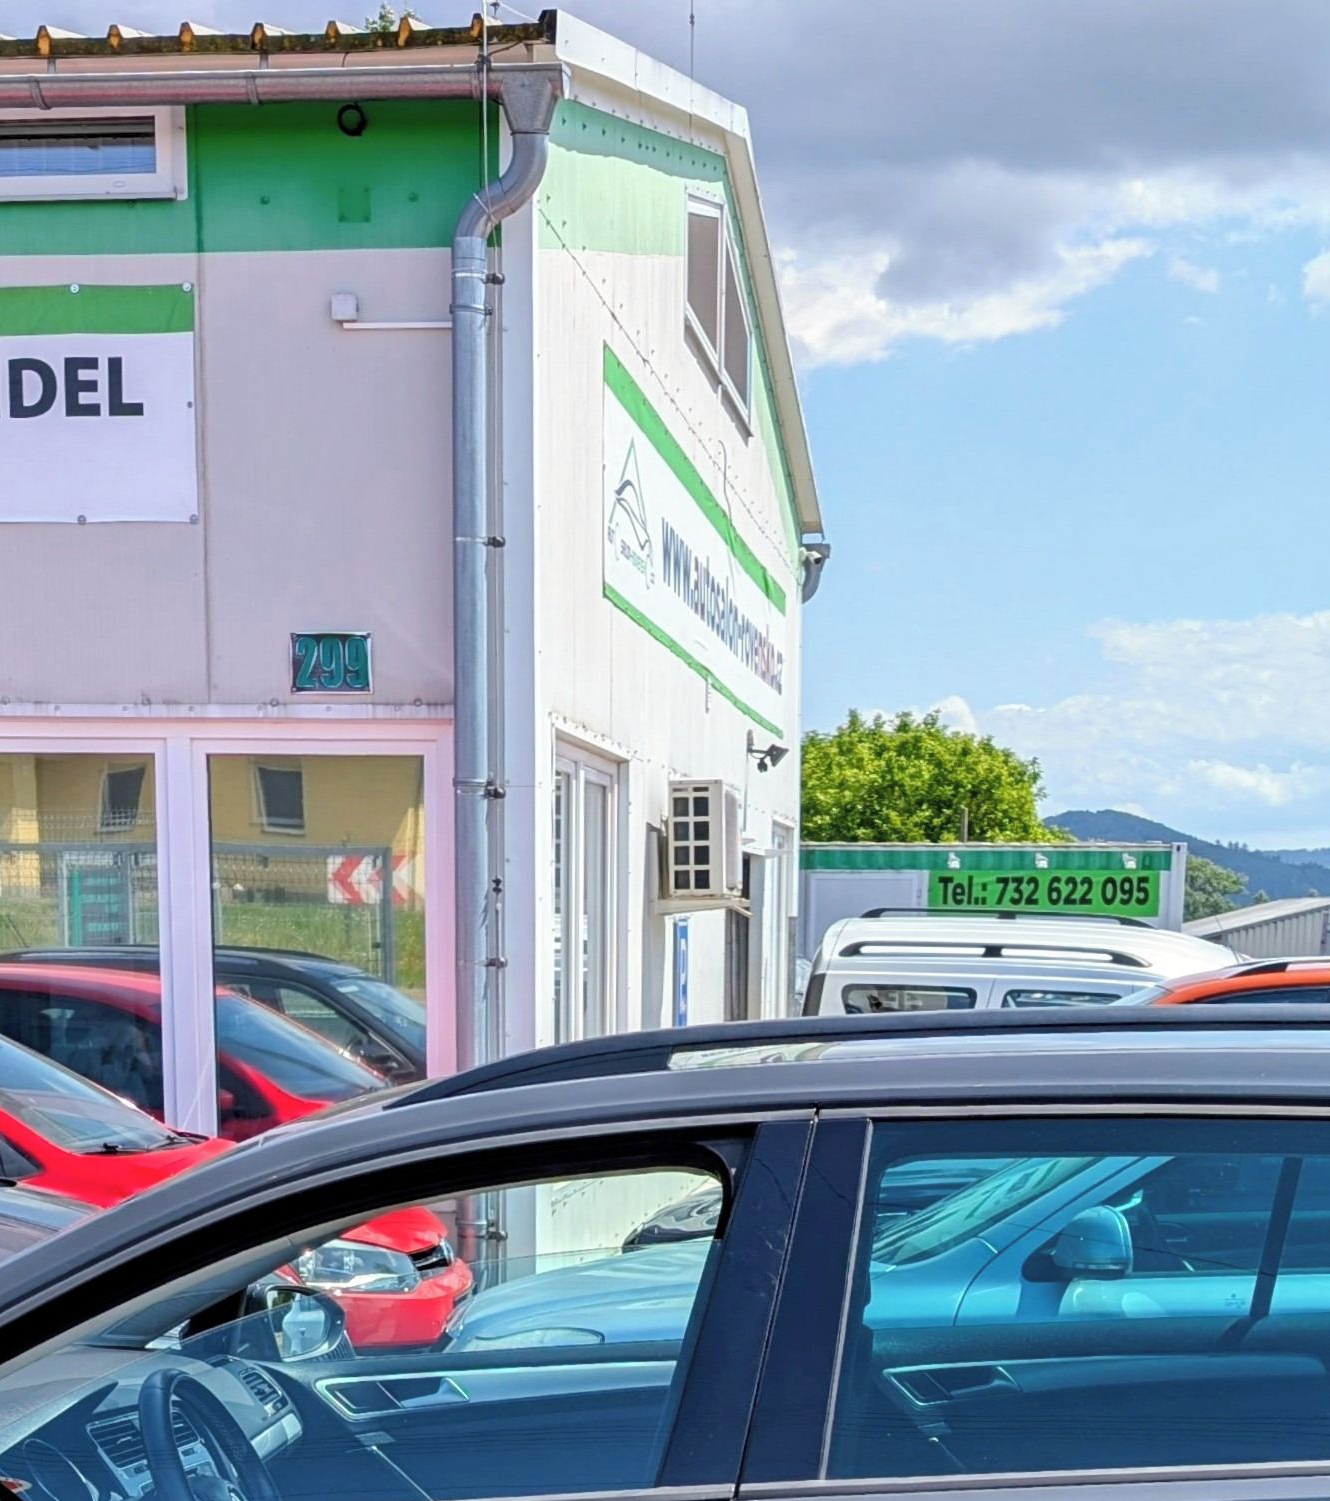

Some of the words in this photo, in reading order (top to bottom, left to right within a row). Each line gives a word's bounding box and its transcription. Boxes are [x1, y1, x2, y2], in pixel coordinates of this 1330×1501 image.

[295, 636, 369, 688] 299
[938, 876, 988, 905] Tel.:
[995, 876, 1039, 906] 732
[1047, 876, 1093, 906] 622
[1101, 876, 1150, 906] 095
